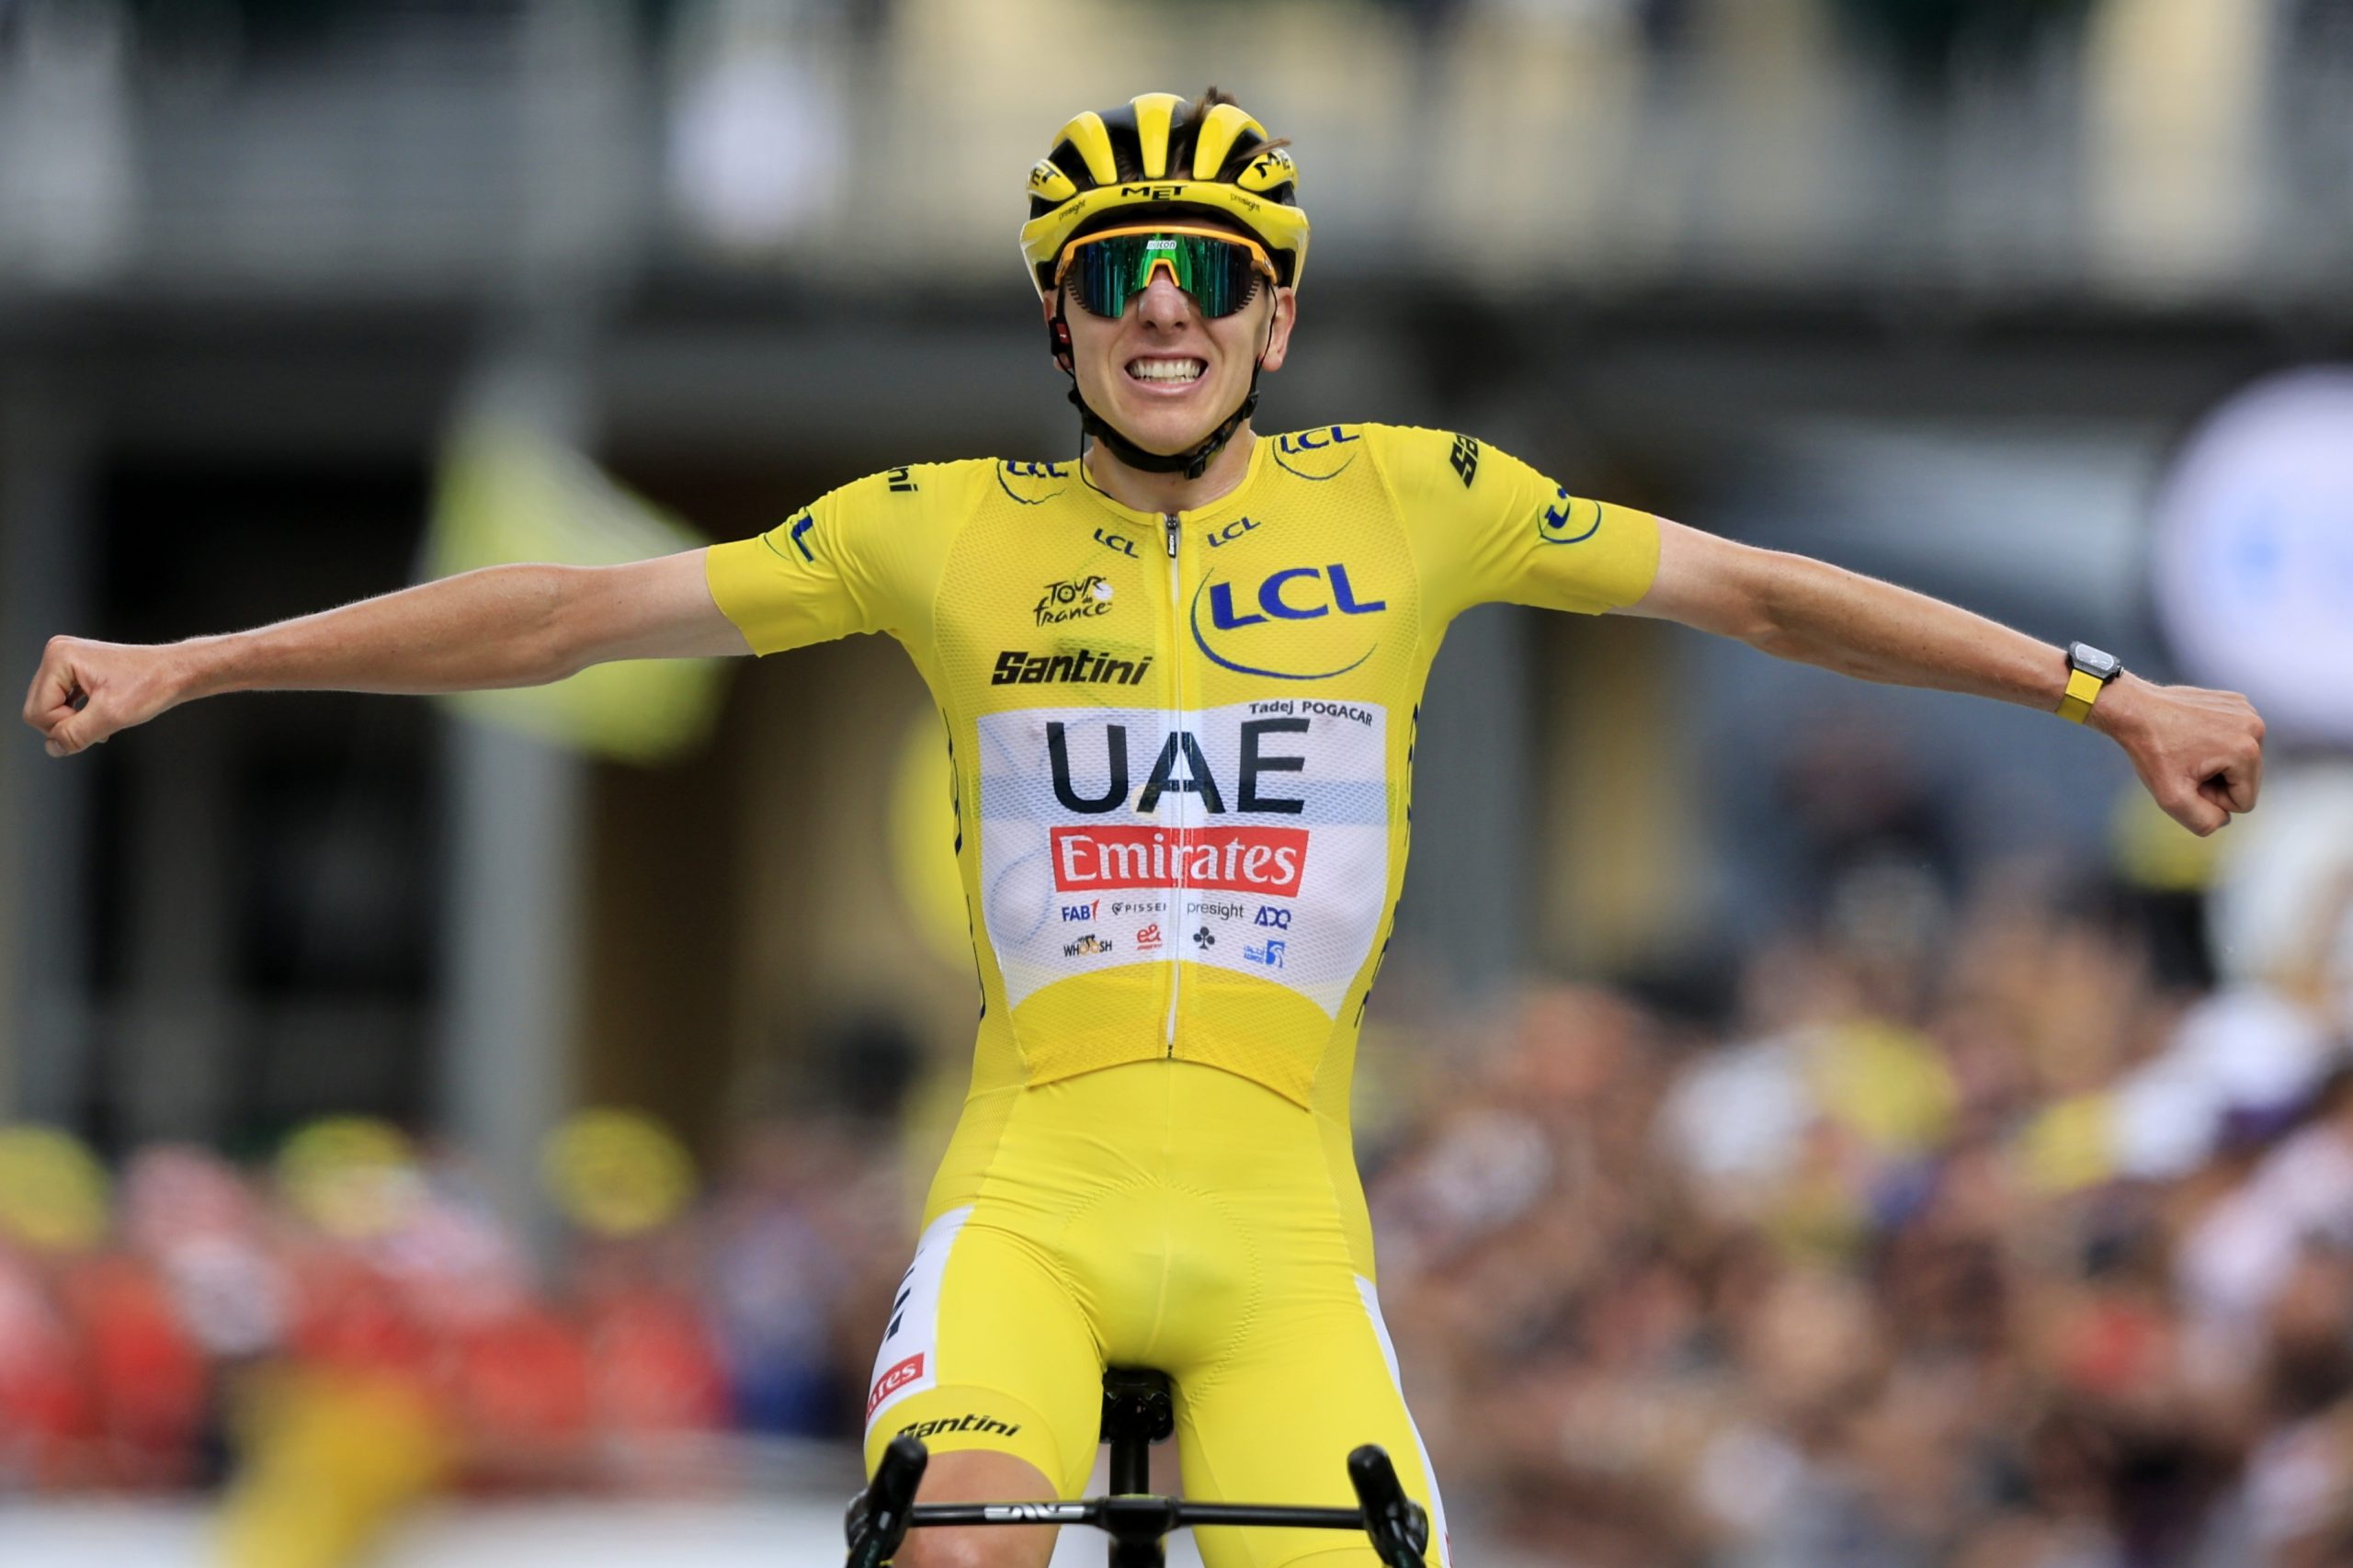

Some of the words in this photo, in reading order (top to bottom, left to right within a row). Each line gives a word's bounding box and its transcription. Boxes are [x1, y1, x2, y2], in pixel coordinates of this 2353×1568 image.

[1121, 186, 1188, 201] MET
[1280, 426, 1359, 454] LCL
[1094, 528, 1139, 558] LCL
[1207, 517, 1261, 547] LCL
[1210, 563, 1386, 631] LCL
[991, 649, 1154, 686] Santini
[1249, 700, 1294, 715] Tadej
[1302, 701, 1373, 726] POGACAR
[1046, 718, 1311, 814] UAE
[1059, 834, 1297, 886] Emirates
[1125, 903, 1166, 913] PISSEI
[1187, 902, 1244, 921] presight
